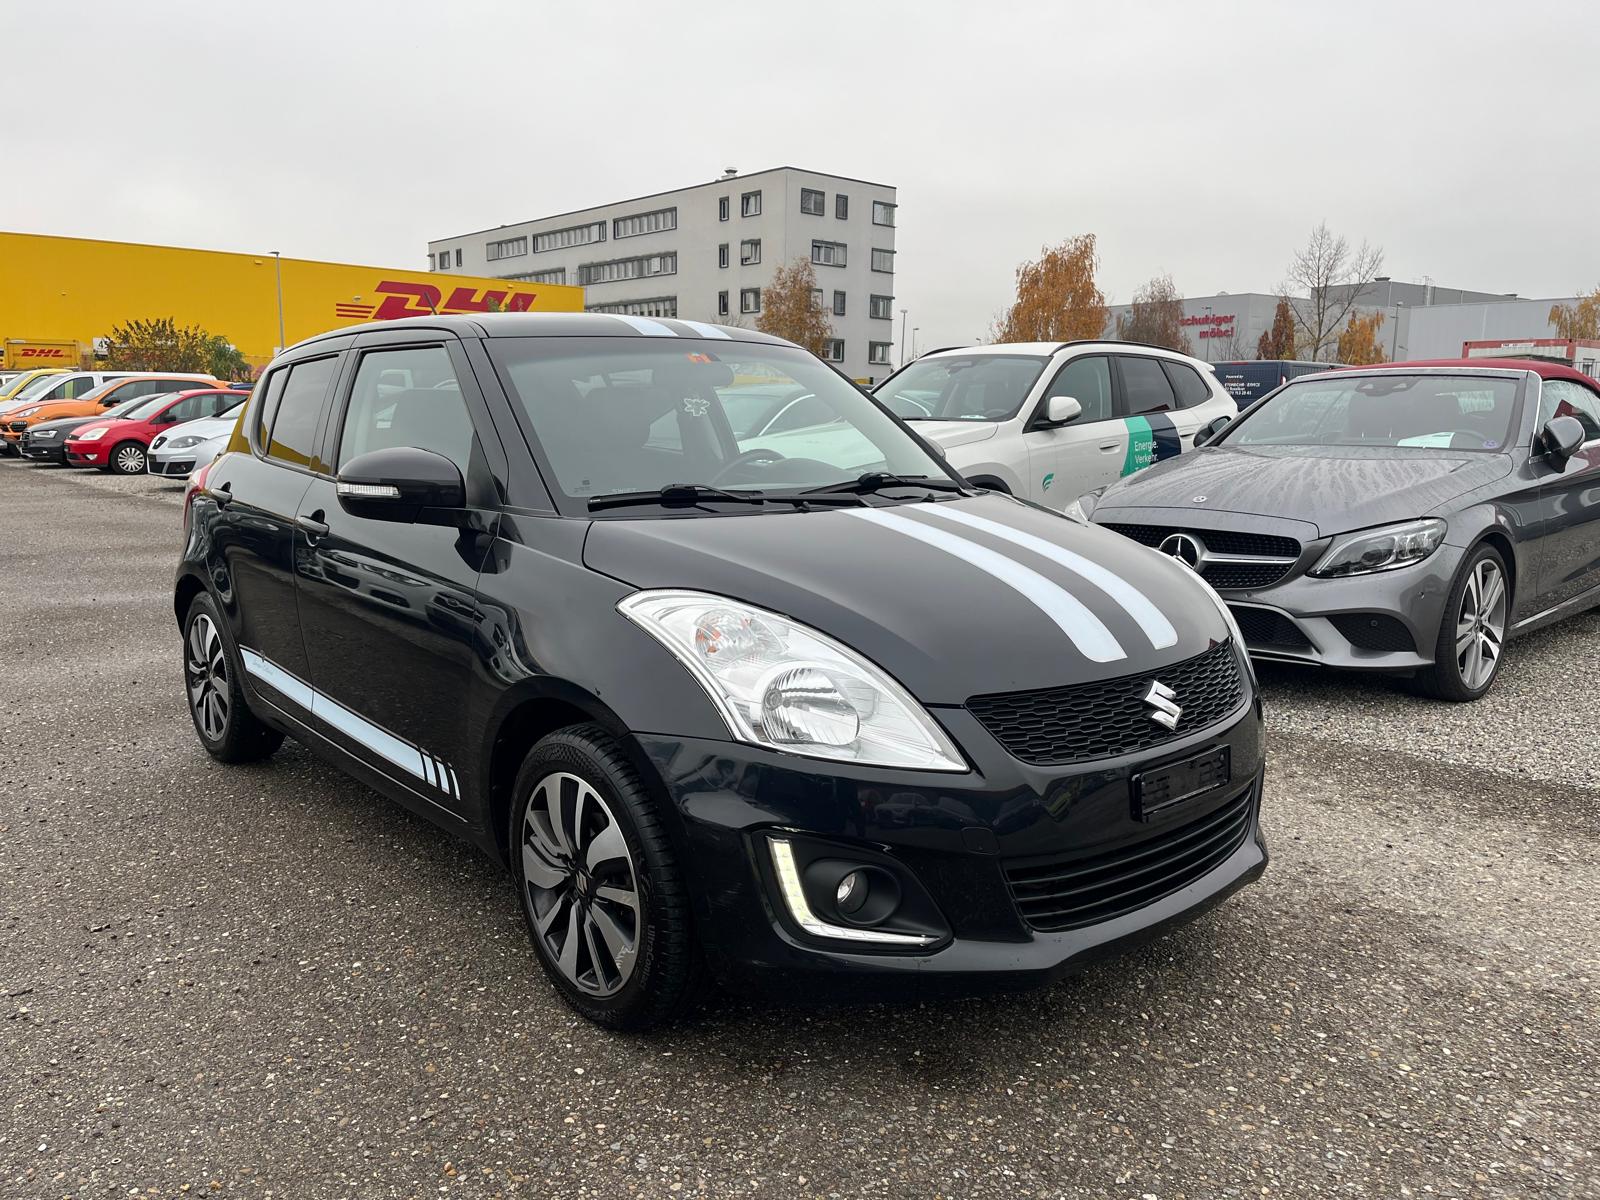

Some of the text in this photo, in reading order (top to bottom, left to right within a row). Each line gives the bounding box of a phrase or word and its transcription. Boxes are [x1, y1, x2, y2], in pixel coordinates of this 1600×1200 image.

[1199, 326, 1235, 339] möbel
[21, 348, 65, 358] DHL
[1134, 440, 1159, 452] Energie.
[1134, 453, 1159, 465] Verkehr.
